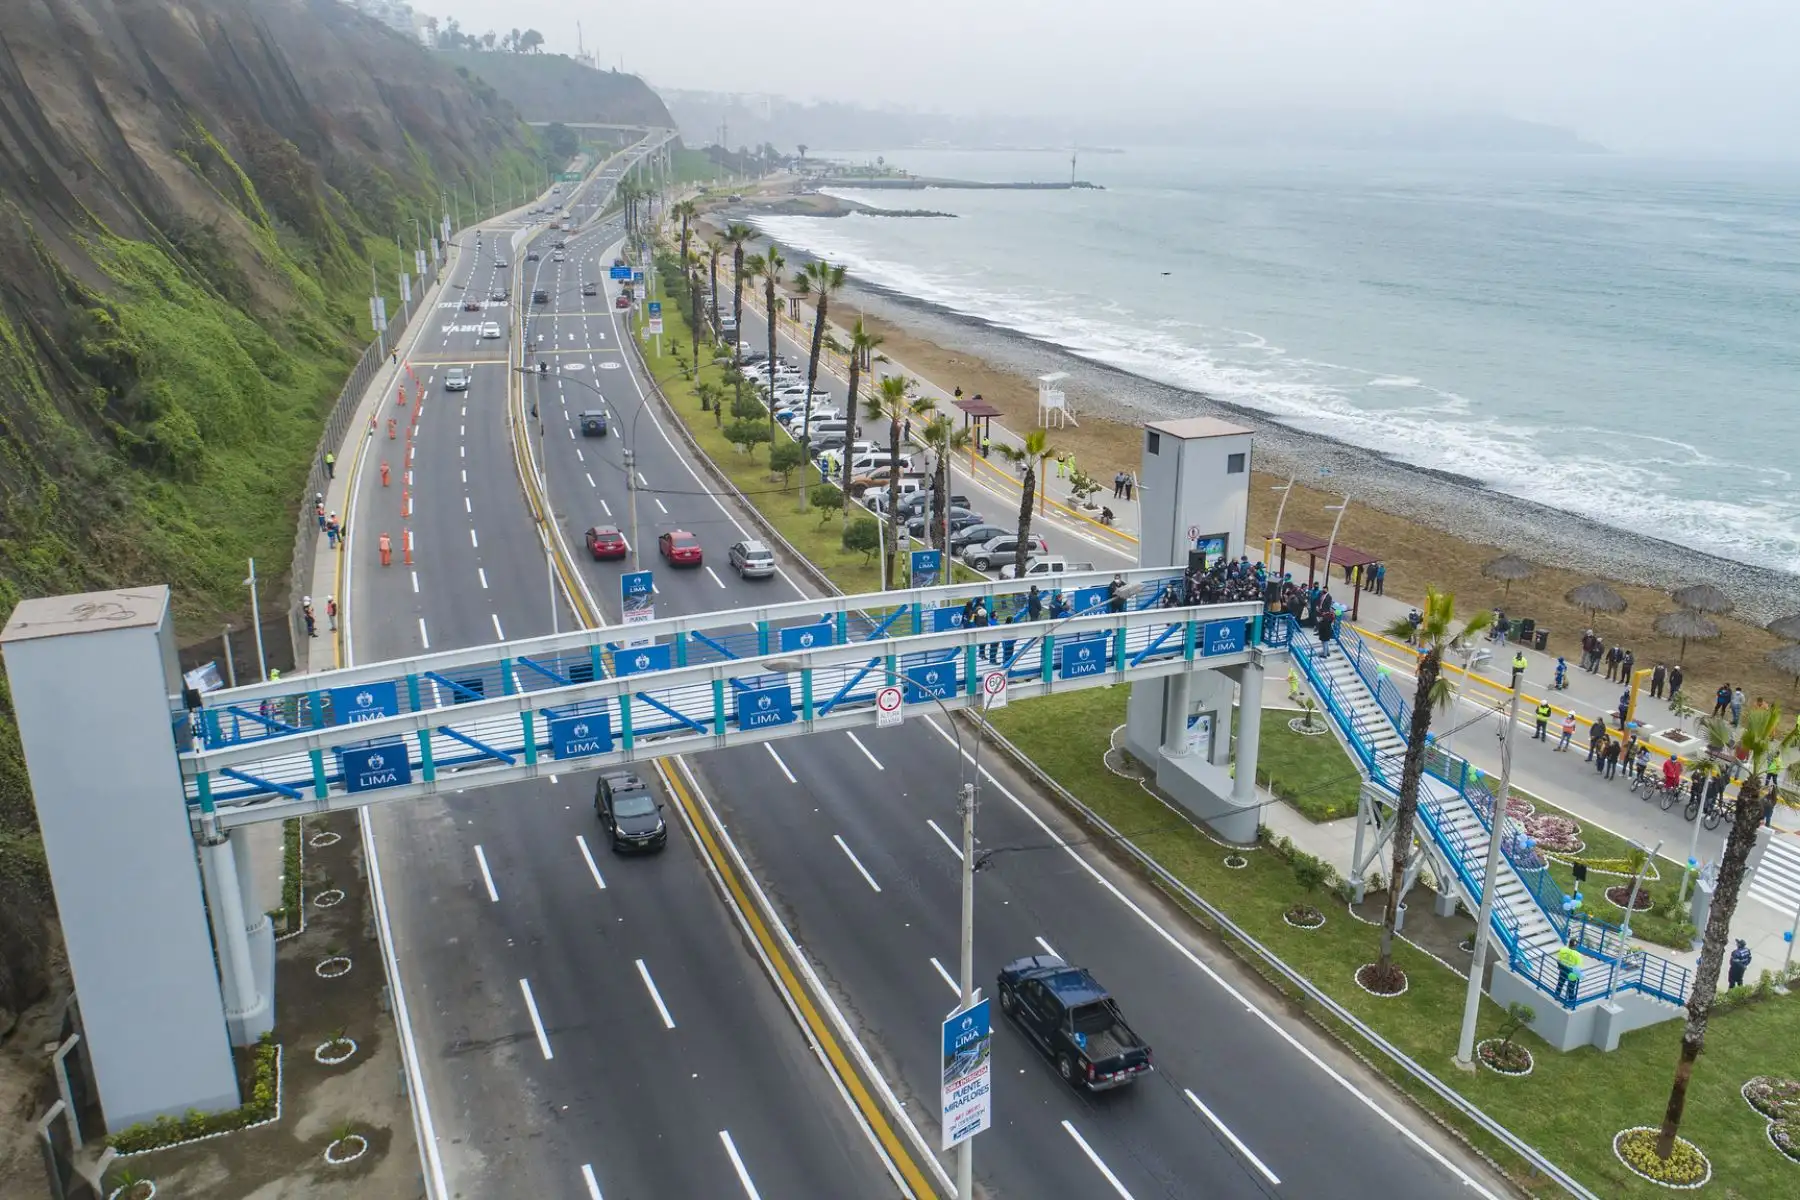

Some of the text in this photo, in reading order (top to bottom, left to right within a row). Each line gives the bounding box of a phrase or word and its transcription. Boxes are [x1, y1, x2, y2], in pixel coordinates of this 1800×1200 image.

[1212, 642, 1236, 653] LIMA
[1071, 663, 1097, 675] LIMA
[989, 676, 1002, 687] 60
[918, 687, 947, 699] LIMA
[750, 713, 781, 726] LIMA
[566, 741, 600, 754] LIMA
[360, 773, 397, 787] LIMA
[955, 1030, 980, 1049] LIMA
[953, 1079, 982, 1100] PUENTE
[944, 1084, 990, 1114] MIRAFLORES
